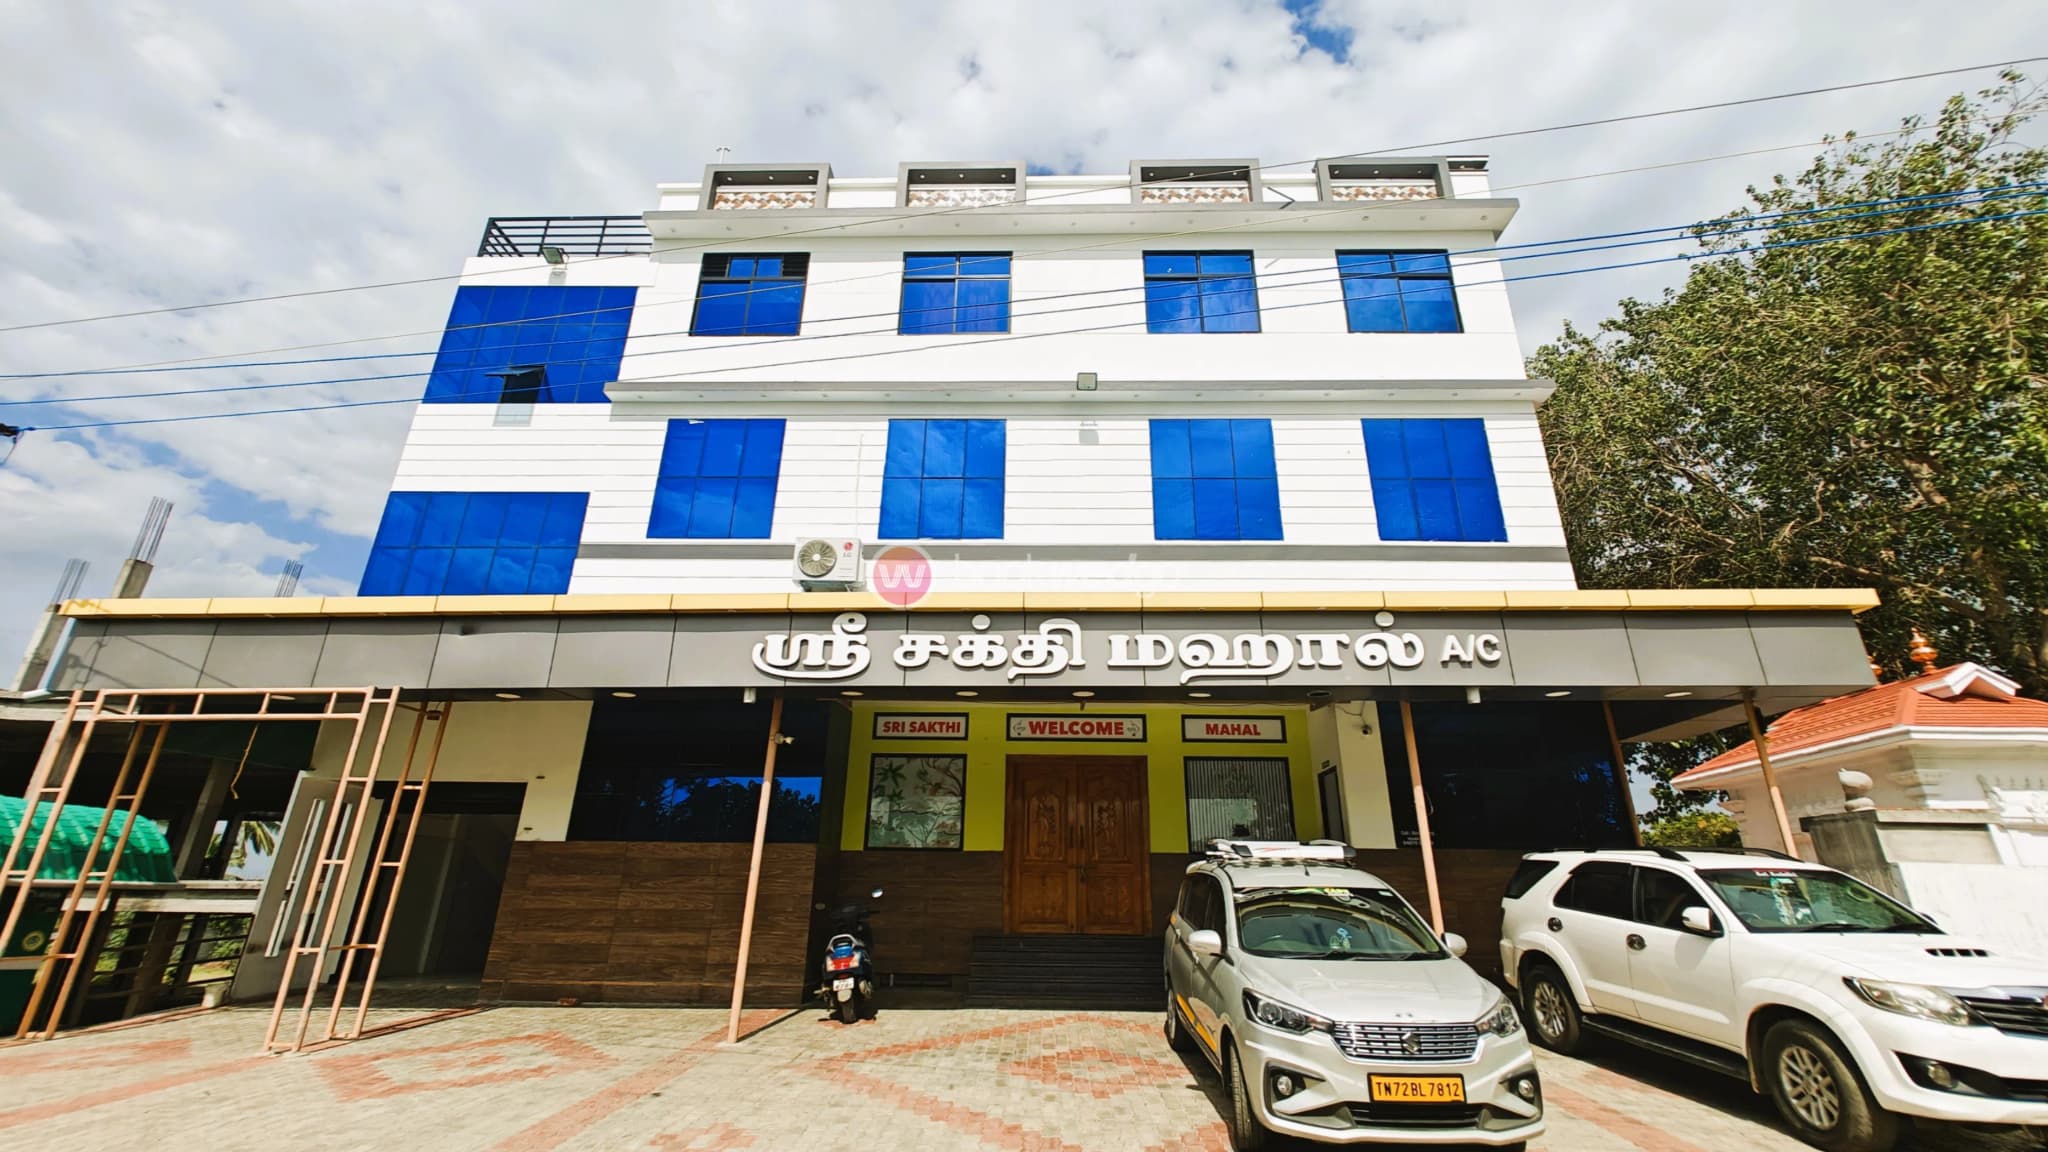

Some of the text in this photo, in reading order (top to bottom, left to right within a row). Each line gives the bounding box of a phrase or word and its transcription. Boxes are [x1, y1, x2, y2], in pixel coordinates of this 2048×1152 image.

[893, 613, 1087, 682] சக்தி
[1107, 611, 1425, 685] மஹால்
[1440, 633, 1503, 665] A/C
[883, 721, 961, 733] SRI SAKTHI
[1028, 720, 1125, 736] WELCOME
[1205, 723, 1262, 736] MAHAL
[1375, 1081, 1460, 1098] TN72BL7812
